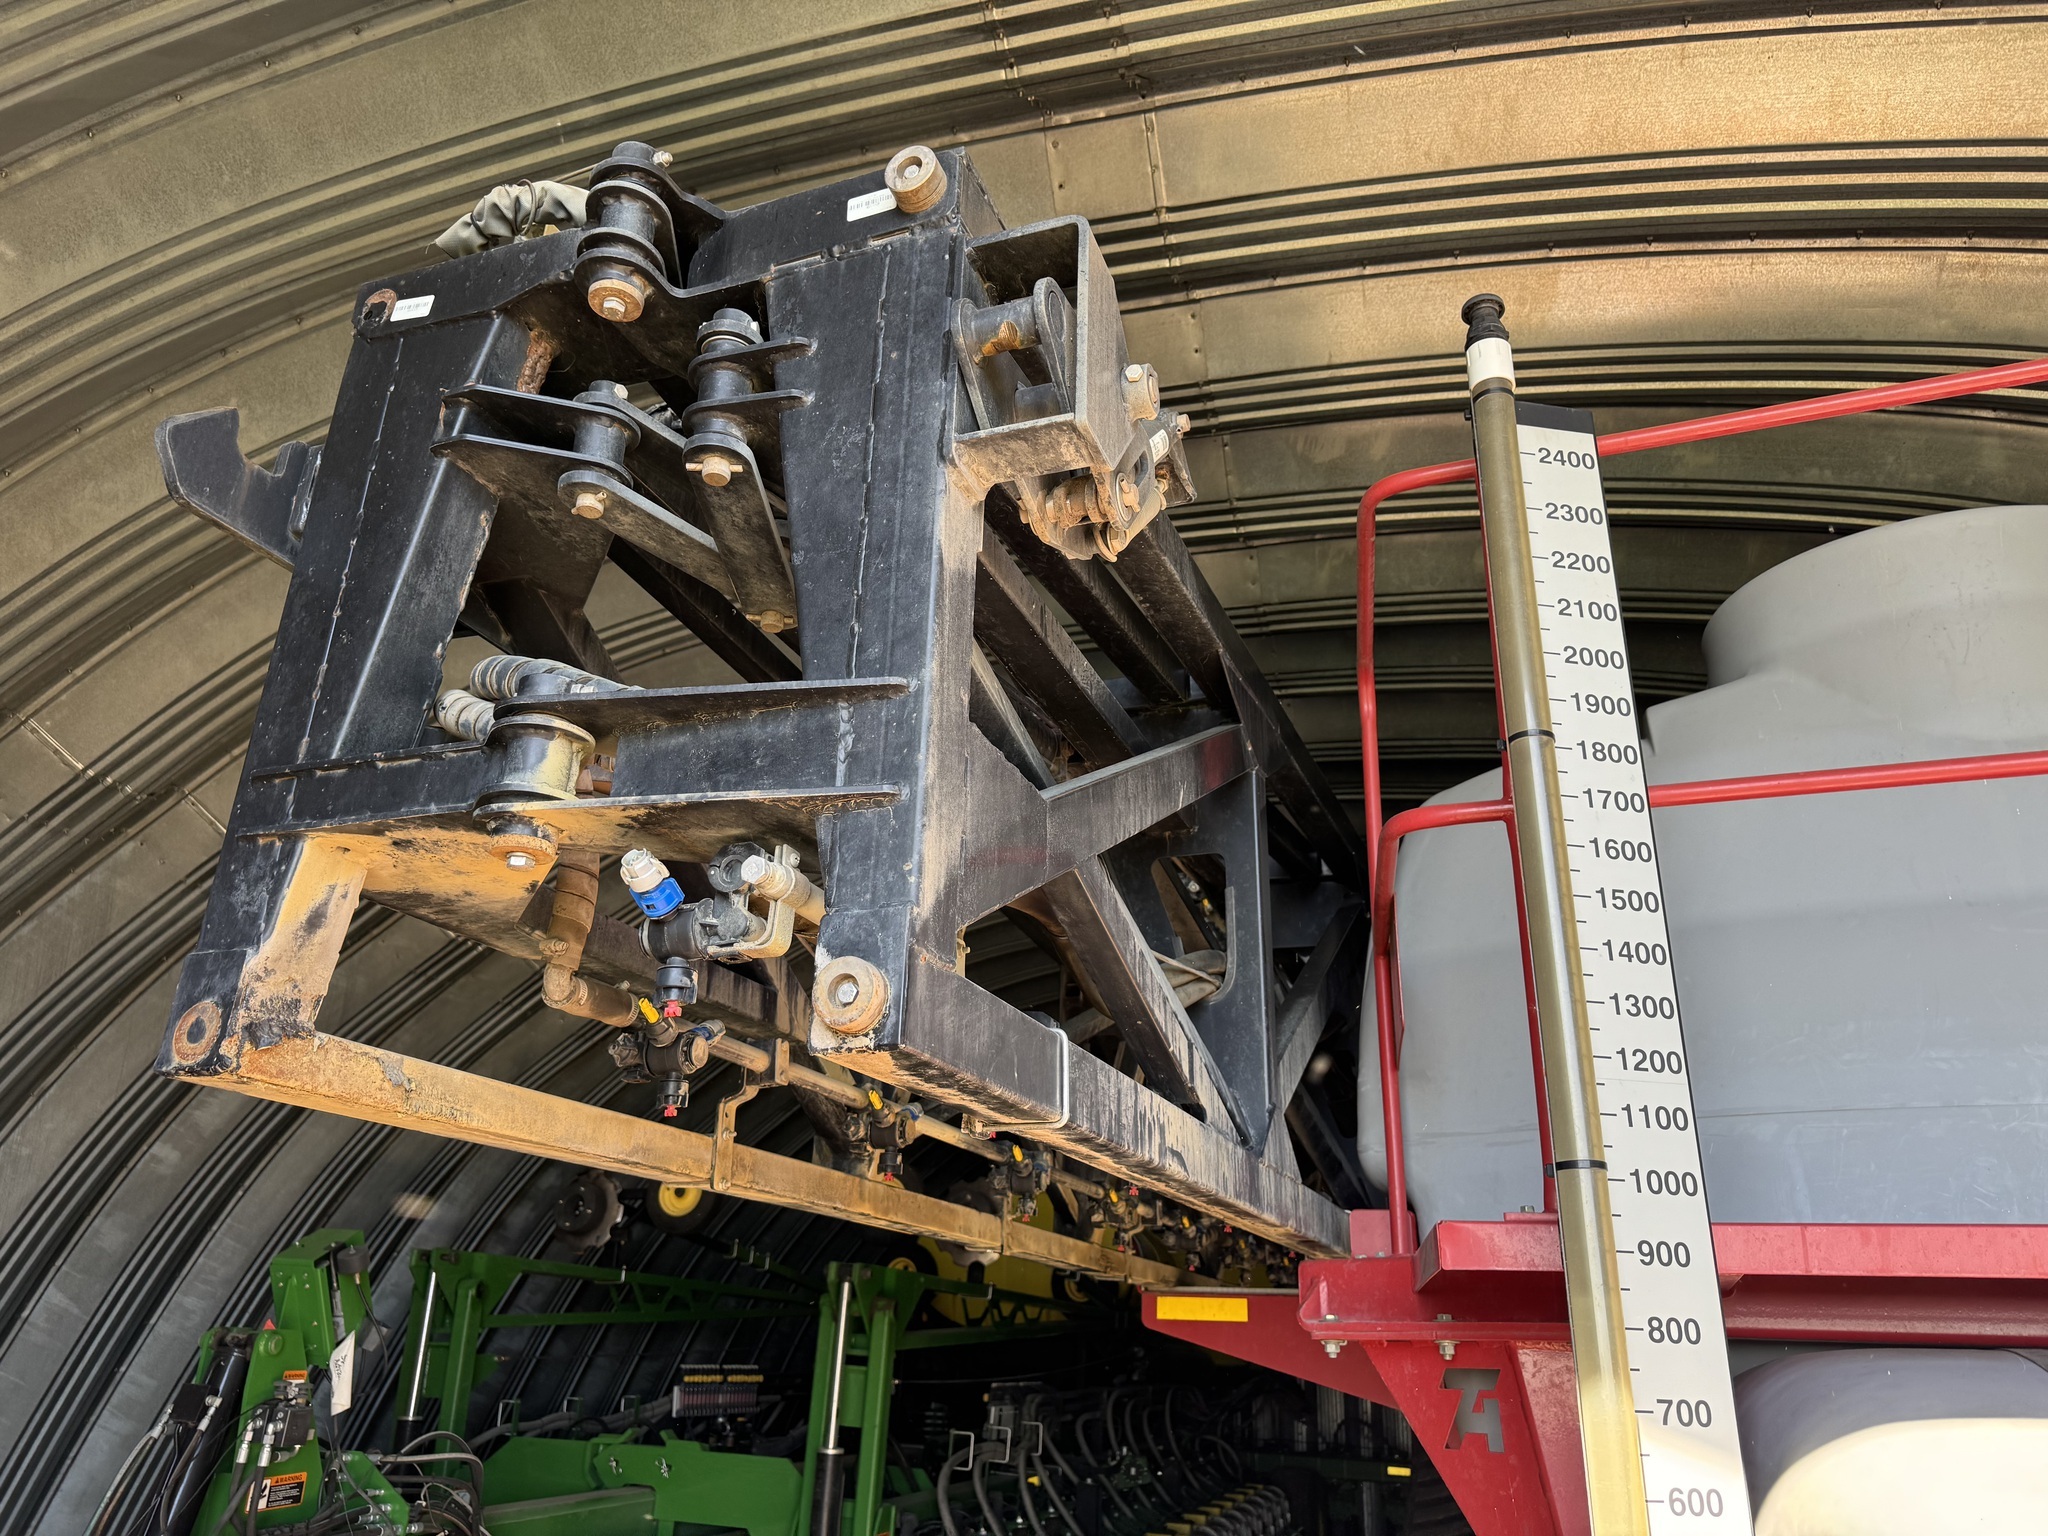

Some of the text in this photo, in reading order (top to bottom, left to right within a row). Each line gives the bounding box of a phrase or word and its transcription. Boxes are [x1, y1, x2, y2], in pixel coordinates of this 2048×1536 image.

[1538, 447, 1595, 470] 2400
[1545, 502, 1604, 525] 2300
[1551, 550, 1611, 574] 2200
[1557, 598, 1618, 622] 2100
[1563, 645, 1625, 670] 2000
[1570, 692, 1631, 717] 1900
[1576, 740, 1638, 765] 1800
[1582, 787, 1645, 814] 1700
[1588, 837, 1653, 863] 1600
[1595, 887, 1660, 914] 1500
[1602, 939, 1667, 966] 1400
[1608, 992, 1675, 1020] 1300
[1615, 1047, 1683, 1075] 1200
[1621, 1103, 1689, 1132] 1100
[1629, 1168, 1698, 1197] 1000
[1637, 1239, 1691, 1268] 900
[1647, 1316, 1701, 1345] 800
[1656, 1398, 1712, 1428] 700
[280, 1474, 303, 1483] WARNING
[1668, 1487, 1724, 1518] 600
